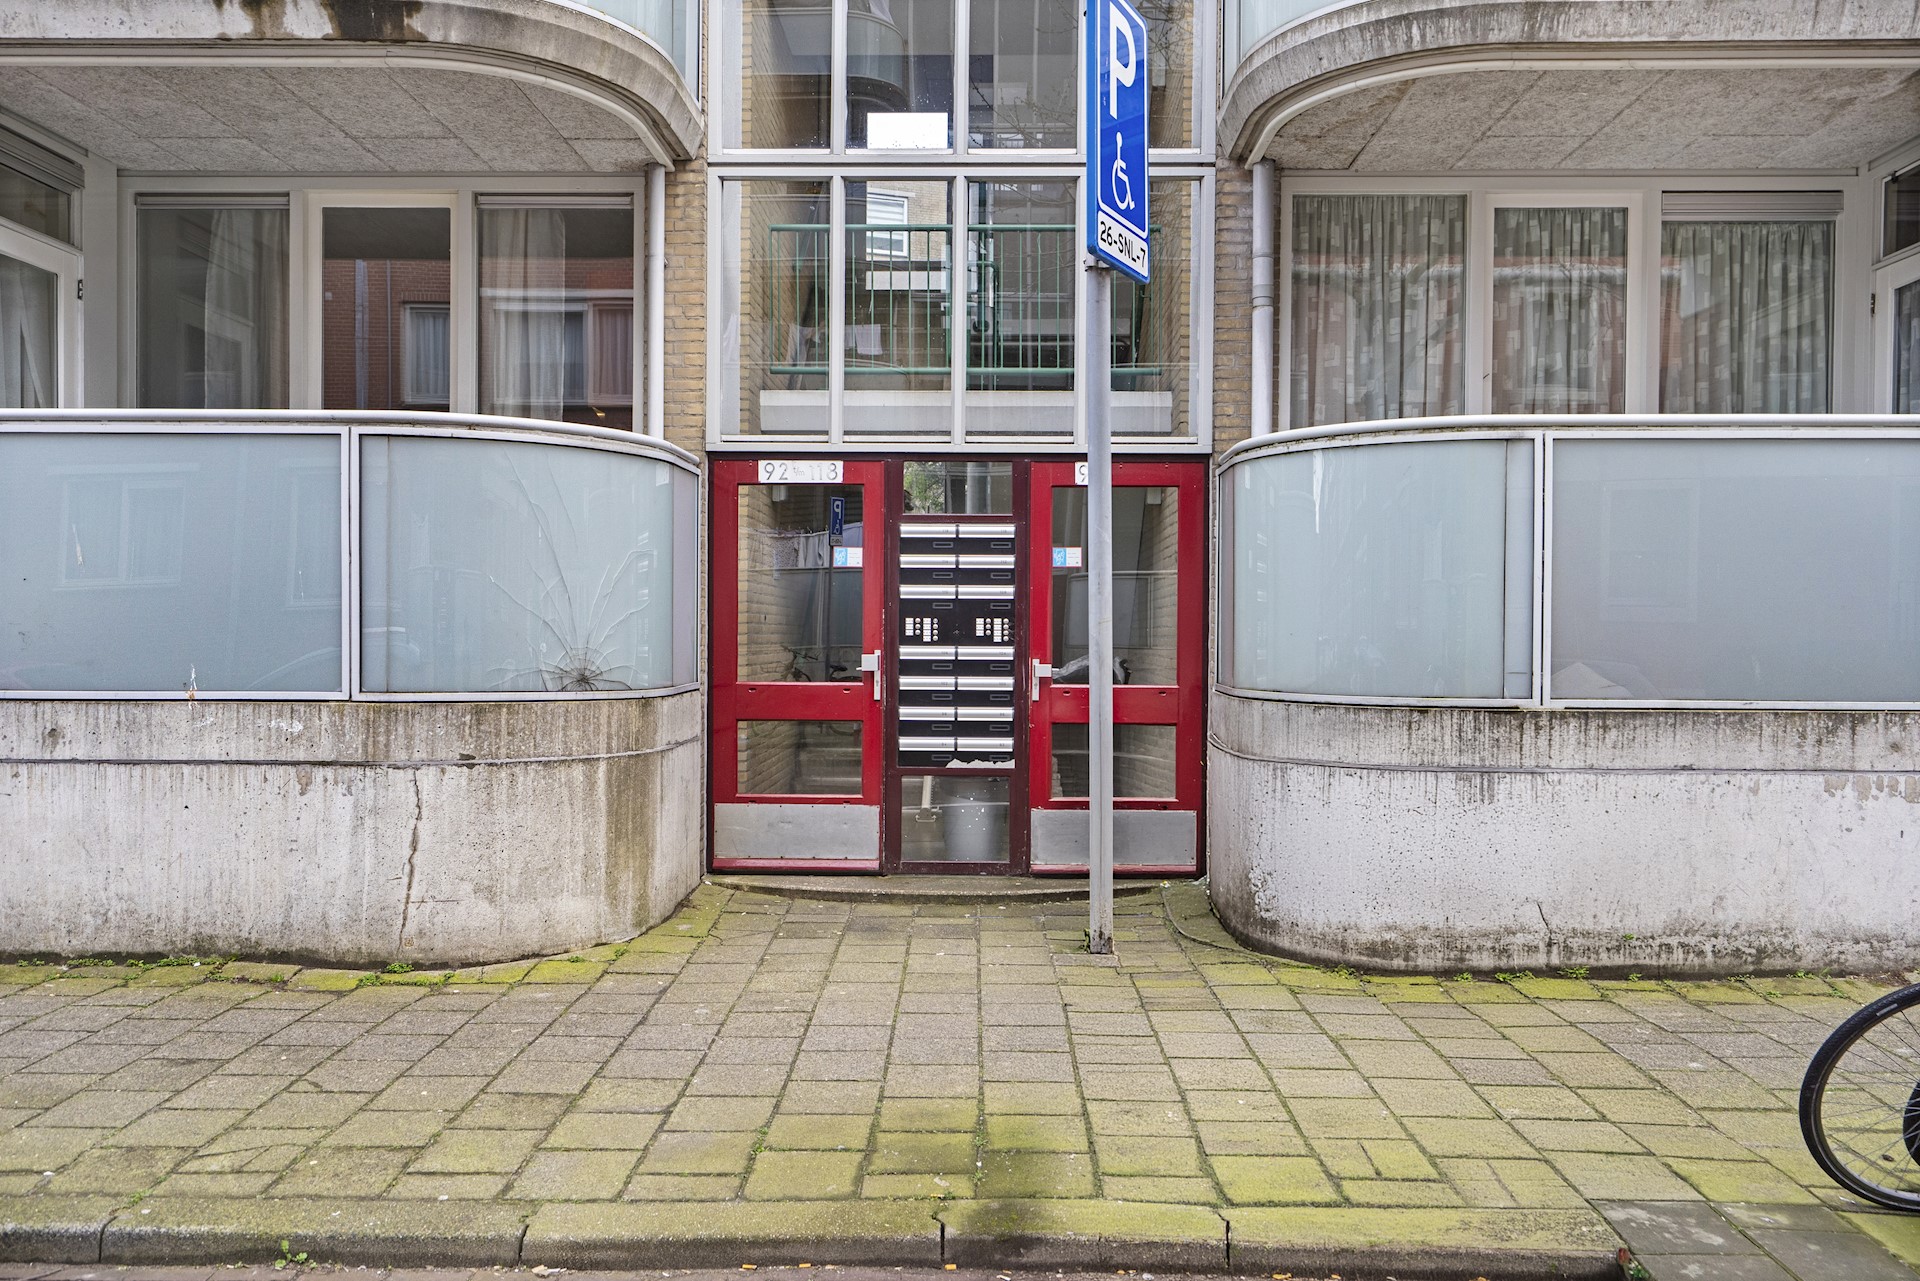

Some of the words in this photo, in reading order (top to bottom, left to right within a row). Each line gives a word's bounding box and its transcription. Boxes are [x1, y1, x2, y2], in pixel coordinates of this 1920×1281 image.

[1110, 2, 1137, 120] P
[1100, 220, 1146, 269] 26-SNL-7
[764, 462, 788, 481] 92
[809, 462, 838, 481] 118
[1079, 464, 1088, 483] 9
